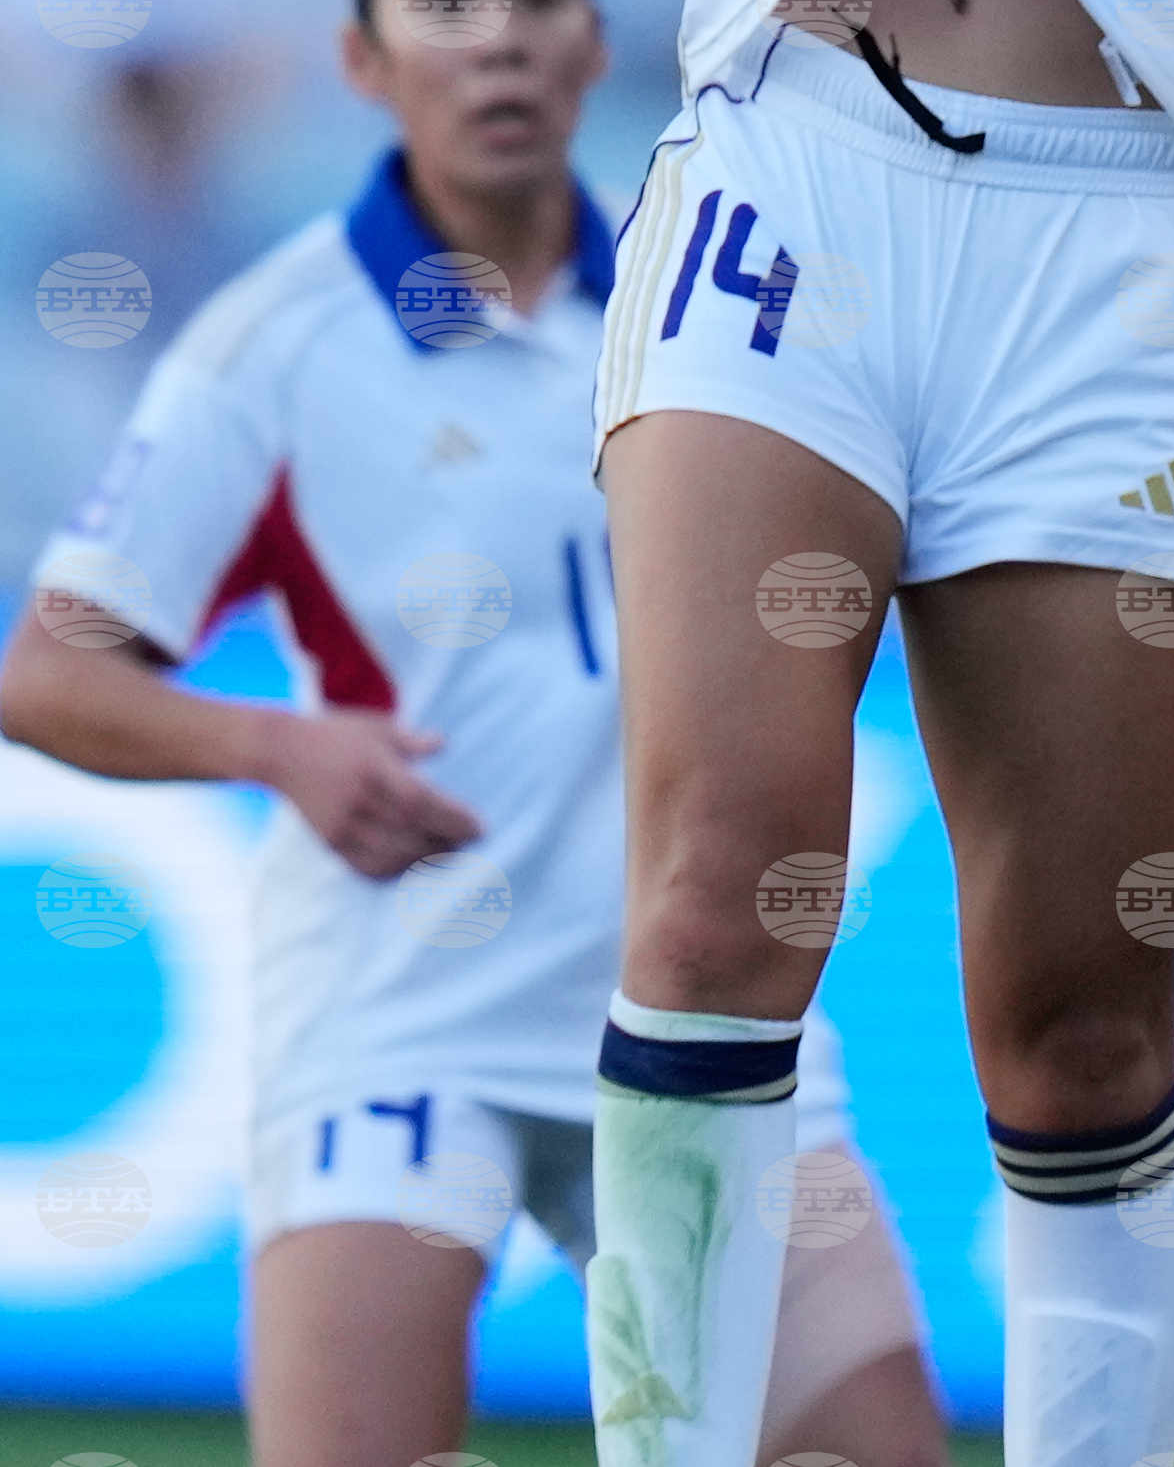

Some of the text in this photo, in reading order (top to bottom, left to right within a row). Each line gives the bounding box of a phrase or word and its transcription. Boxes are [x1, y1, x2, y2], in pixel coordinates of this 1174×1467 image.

[660, 190, 799, 358] 14
[562, 531, 613, 679] 1
[315, 1092, 433, 1175] 17
